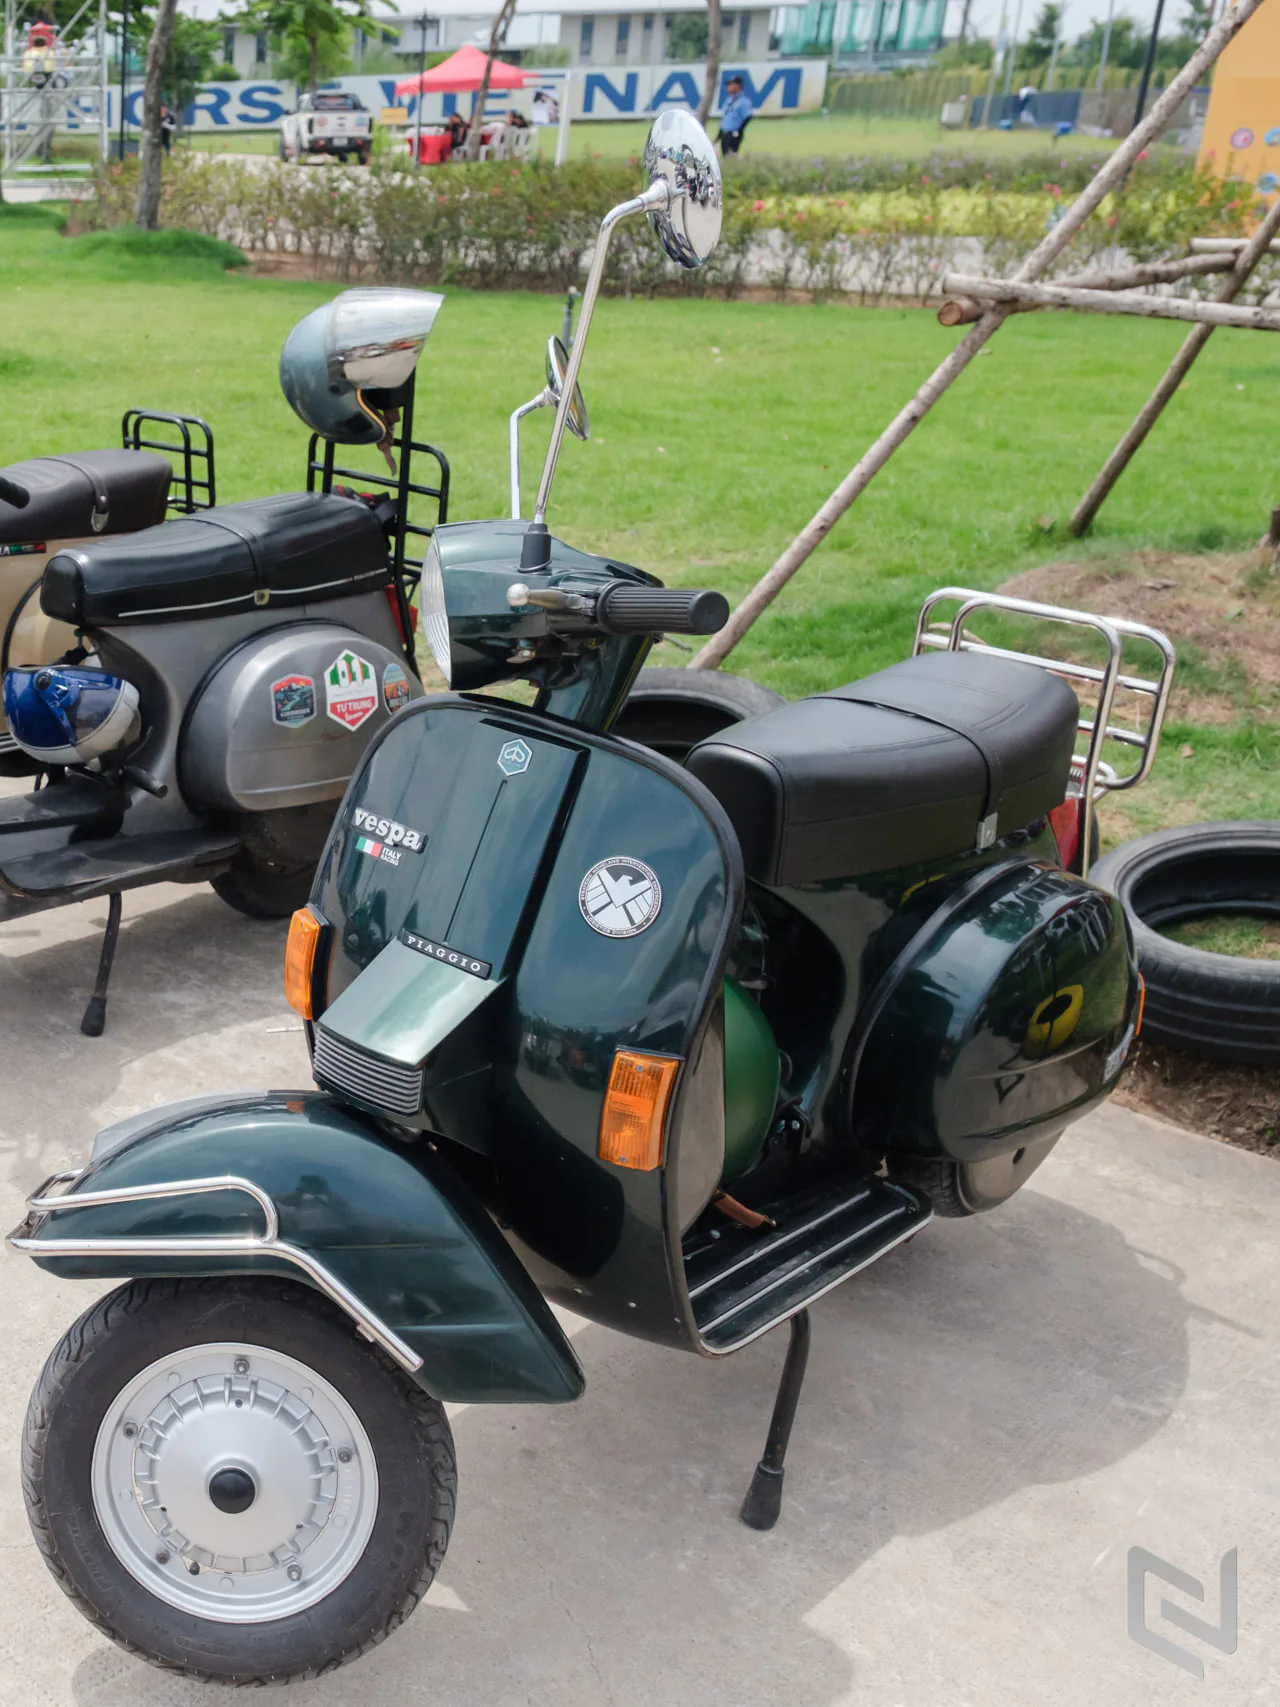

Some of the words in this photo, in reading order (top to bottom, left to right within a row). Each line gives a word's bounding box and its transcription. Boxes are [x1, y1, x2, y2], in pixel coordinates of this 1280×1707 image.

[67, 81, 342, 129] HORS
[379, 67, 802, 119] VIENAM
[354, 808, 421, 850] vespa
[380, 854, 400, 866] RACING
[382, 847, 402, 860] ITALY
[407, 935, 481, 972] PIAGGIO
